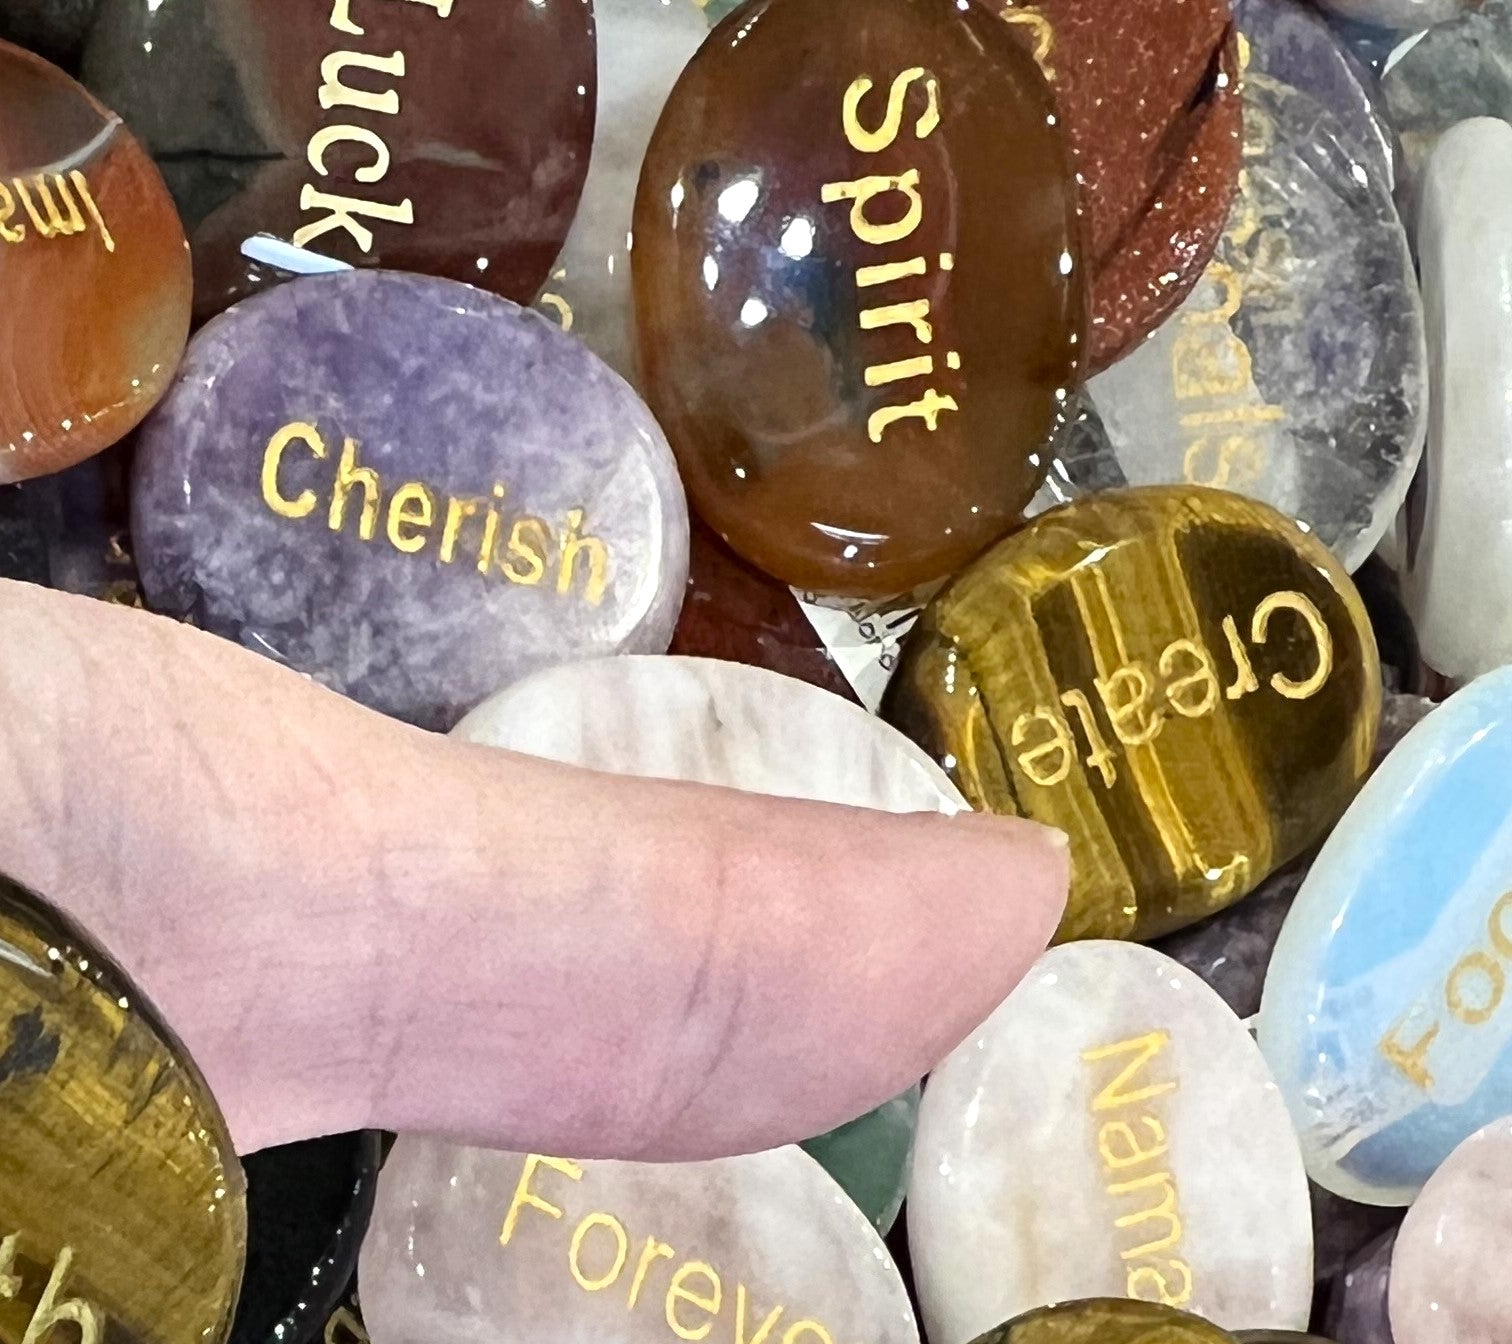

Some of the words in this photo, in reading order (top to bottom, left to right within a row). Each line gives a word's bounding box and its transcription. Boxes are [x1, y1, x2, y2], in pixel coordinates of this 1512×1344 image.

[821, 66, 960, 443] Spirit
[260, 421, 608, 606] Cherish
[1011, 591, 1333, 788] Create
[1081, 1029, 1193, 1306] Nama
